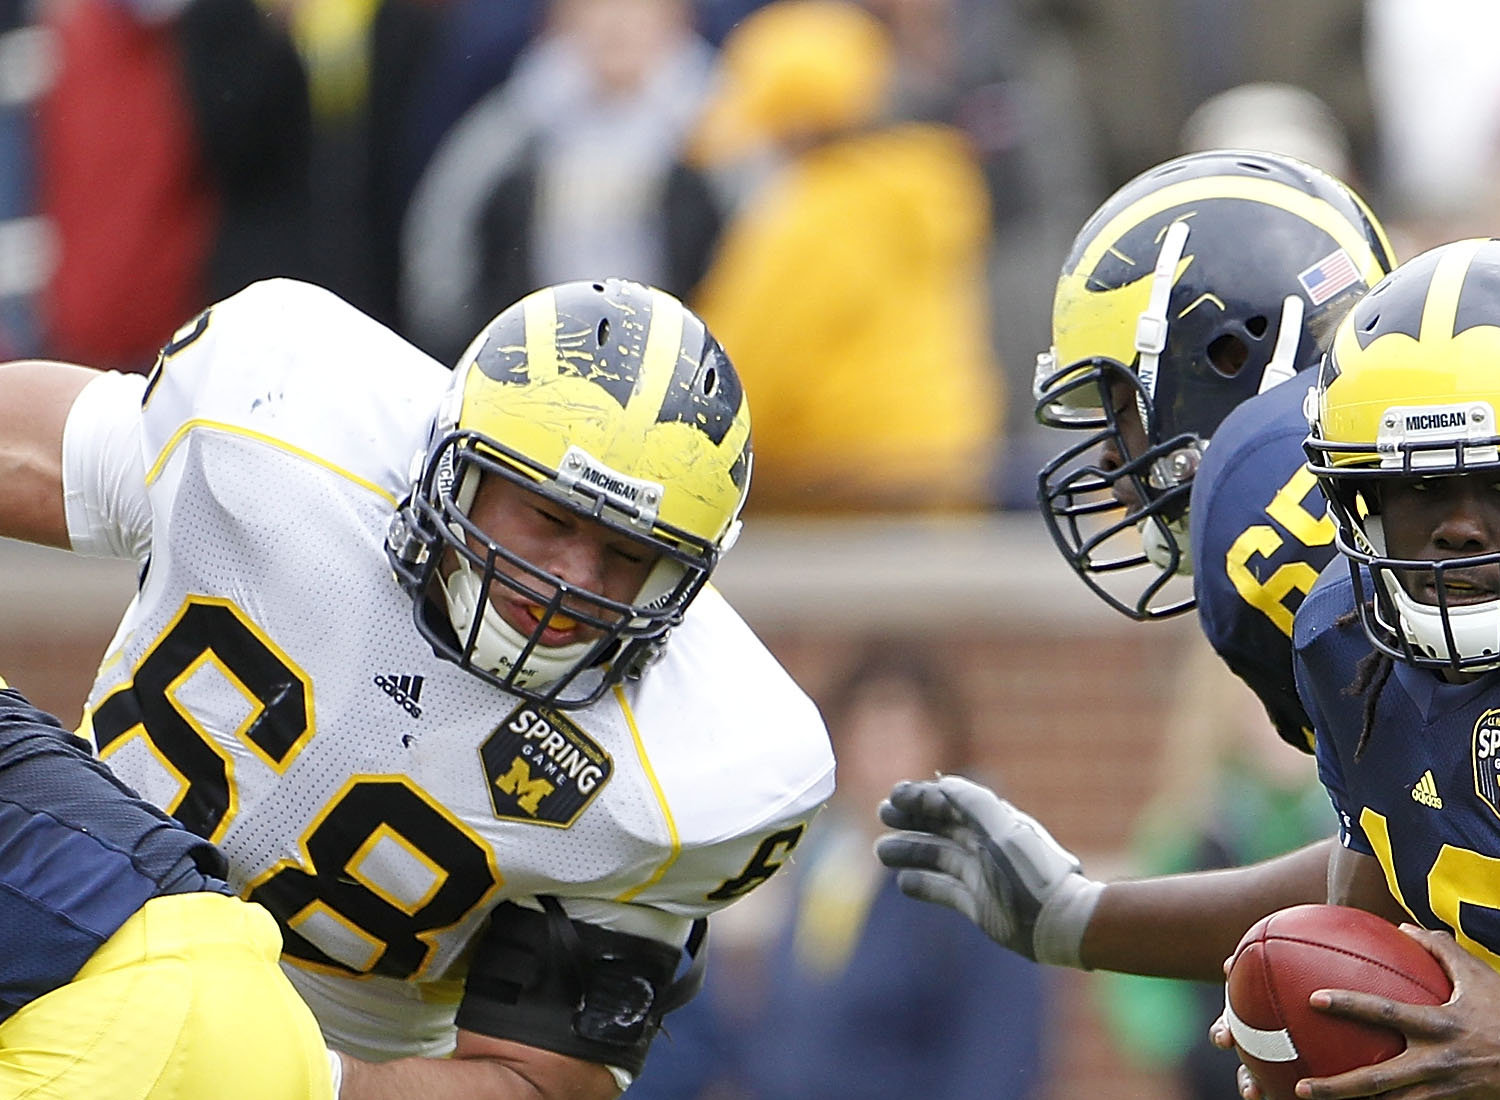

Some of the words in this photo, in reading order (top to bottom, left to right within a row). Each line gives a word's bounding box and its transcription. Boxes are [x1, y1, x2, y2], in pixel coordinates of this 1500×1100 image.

[1405, 411, 1467, 431] MICHIGAN
[582, 466, 639, 502] MICHIGAN
[373, 675, 422, 719] adidas
[508, 709, 603, 795] SPRING
[521, 744, 567, 786] GAME
[74, 593, 503, 981] 68
[494, 756, 556, 819] M
[1411, 788, 1443, 810] adidas
